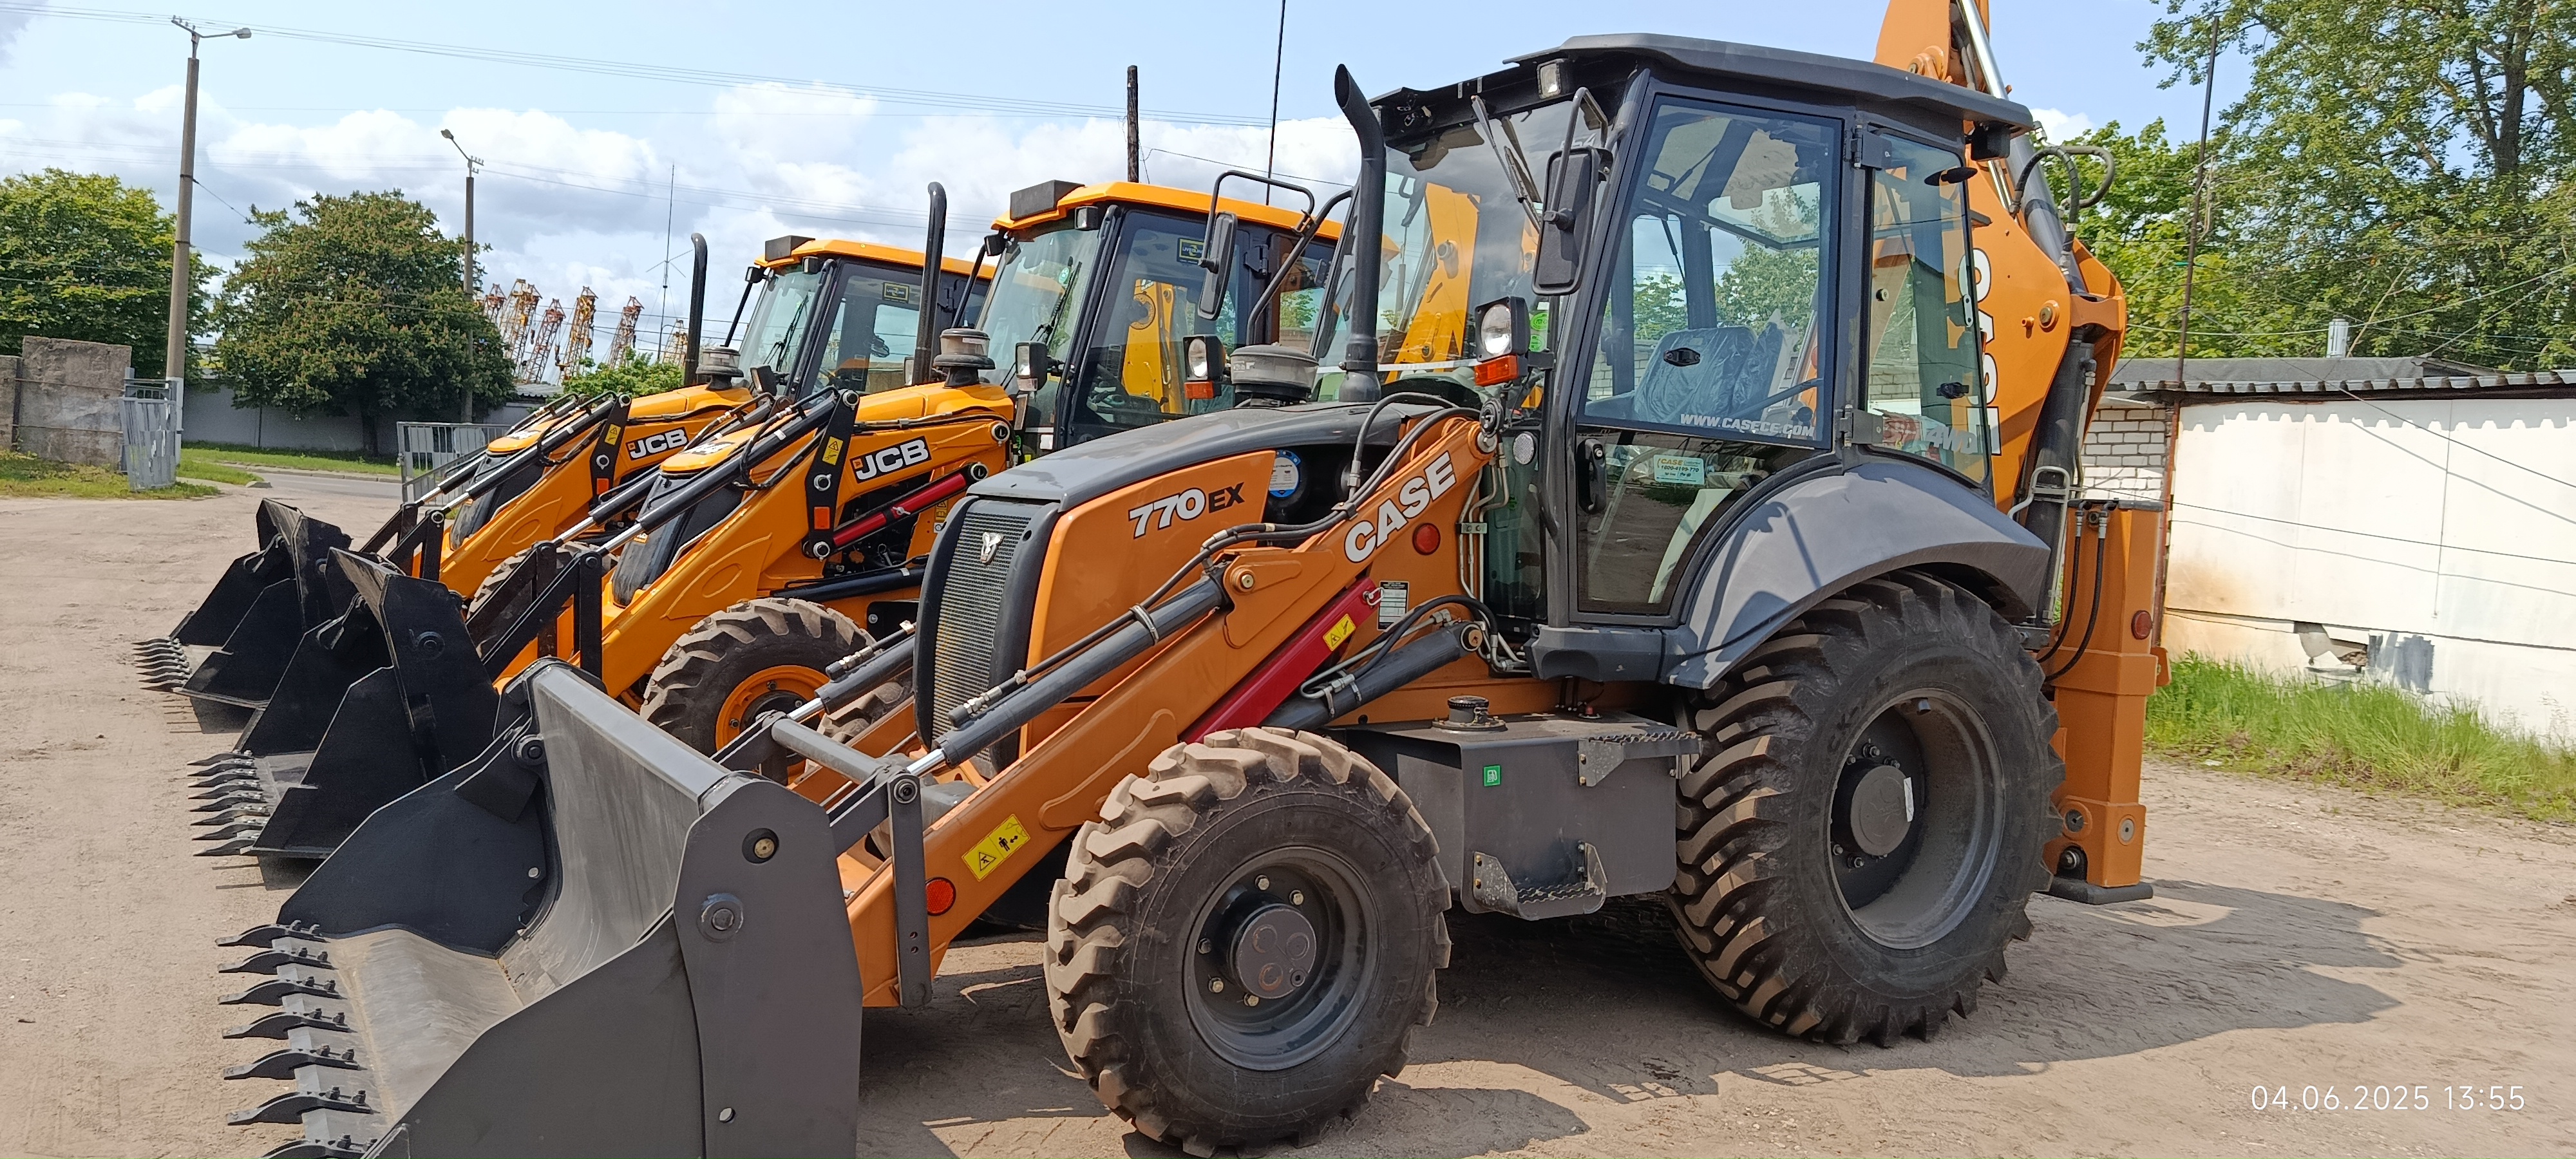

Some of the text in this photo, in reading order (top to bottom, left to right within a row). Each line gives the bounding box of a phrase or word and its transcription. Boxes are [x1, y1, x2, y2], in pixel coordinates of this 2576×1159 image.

[1680, 413, 1815, 437] WWW.CASECE.COM
[1926, 425, 1978, 455] 4WD
[630, 429, 688, 458] JCB
[855, 439, 929, 480] JCB
[1344, 449, 1457, 563] CASE
